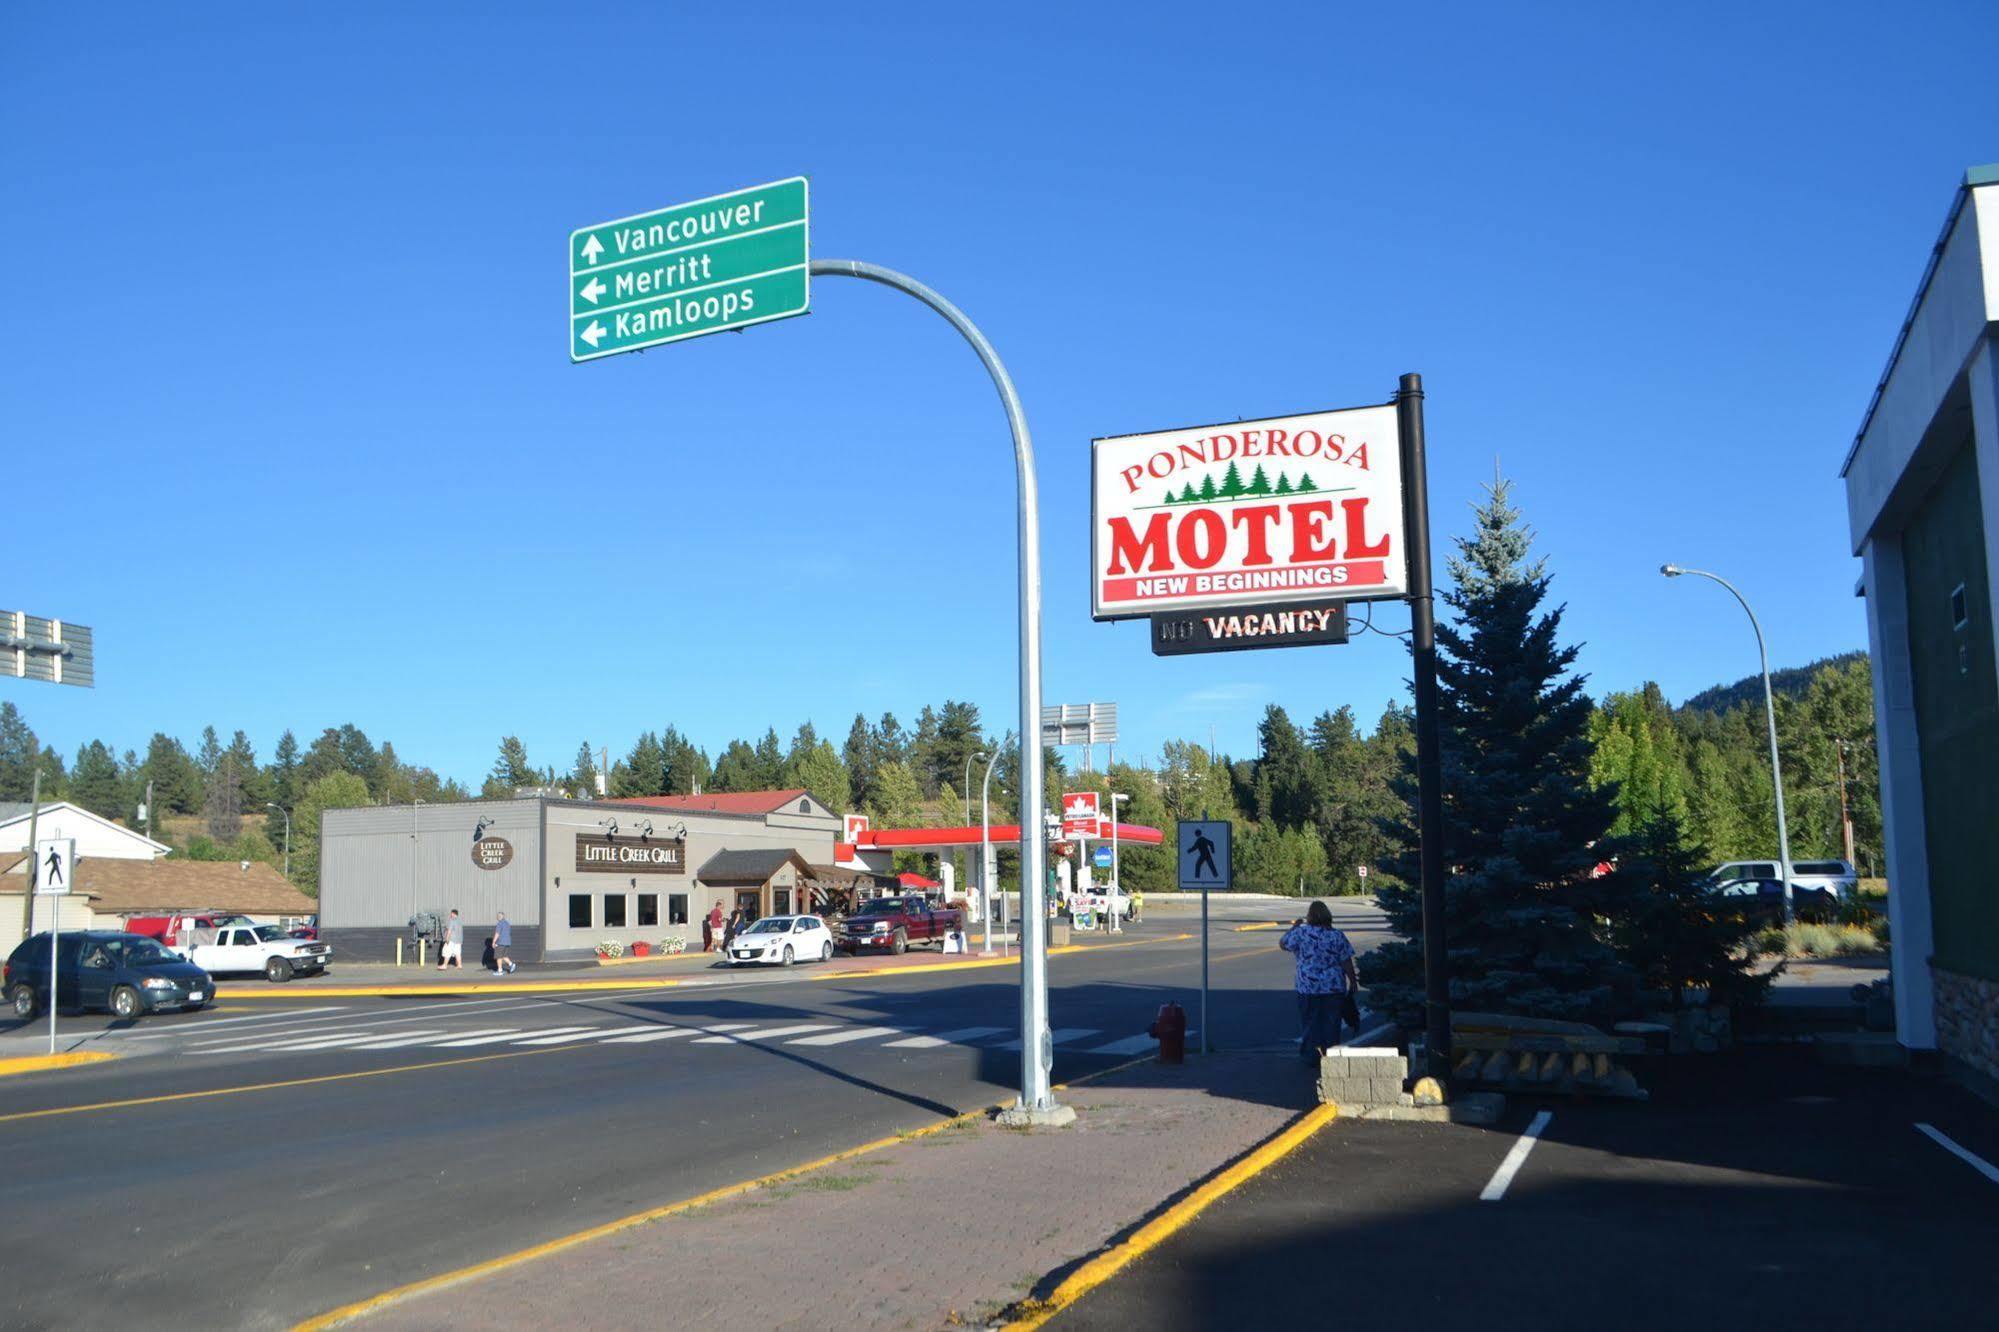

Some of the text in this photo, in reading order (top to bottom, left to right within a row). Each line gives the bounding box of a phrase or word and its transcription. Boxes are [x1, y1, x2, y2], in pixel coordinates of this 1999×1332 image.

[614, 199, 765, 254] Vancouver
[615, 254, 711, 298] Merritt
[615, 289, 754, 338] Kamloops
[1119, 429, 1370, 494] PONDEROSA
[1106, 497, 1390, 576] MOTEL
[1136, 566, 1349, 597] NEW BEGINNINGS
[1161, 609, 1334, 641] NO VACANCY
[480, 842, 504, 850] LITTLE
[480, 849, 504, 857] CREEK
[585, 844, 678, 863] LITTLE CREEK GRILL
